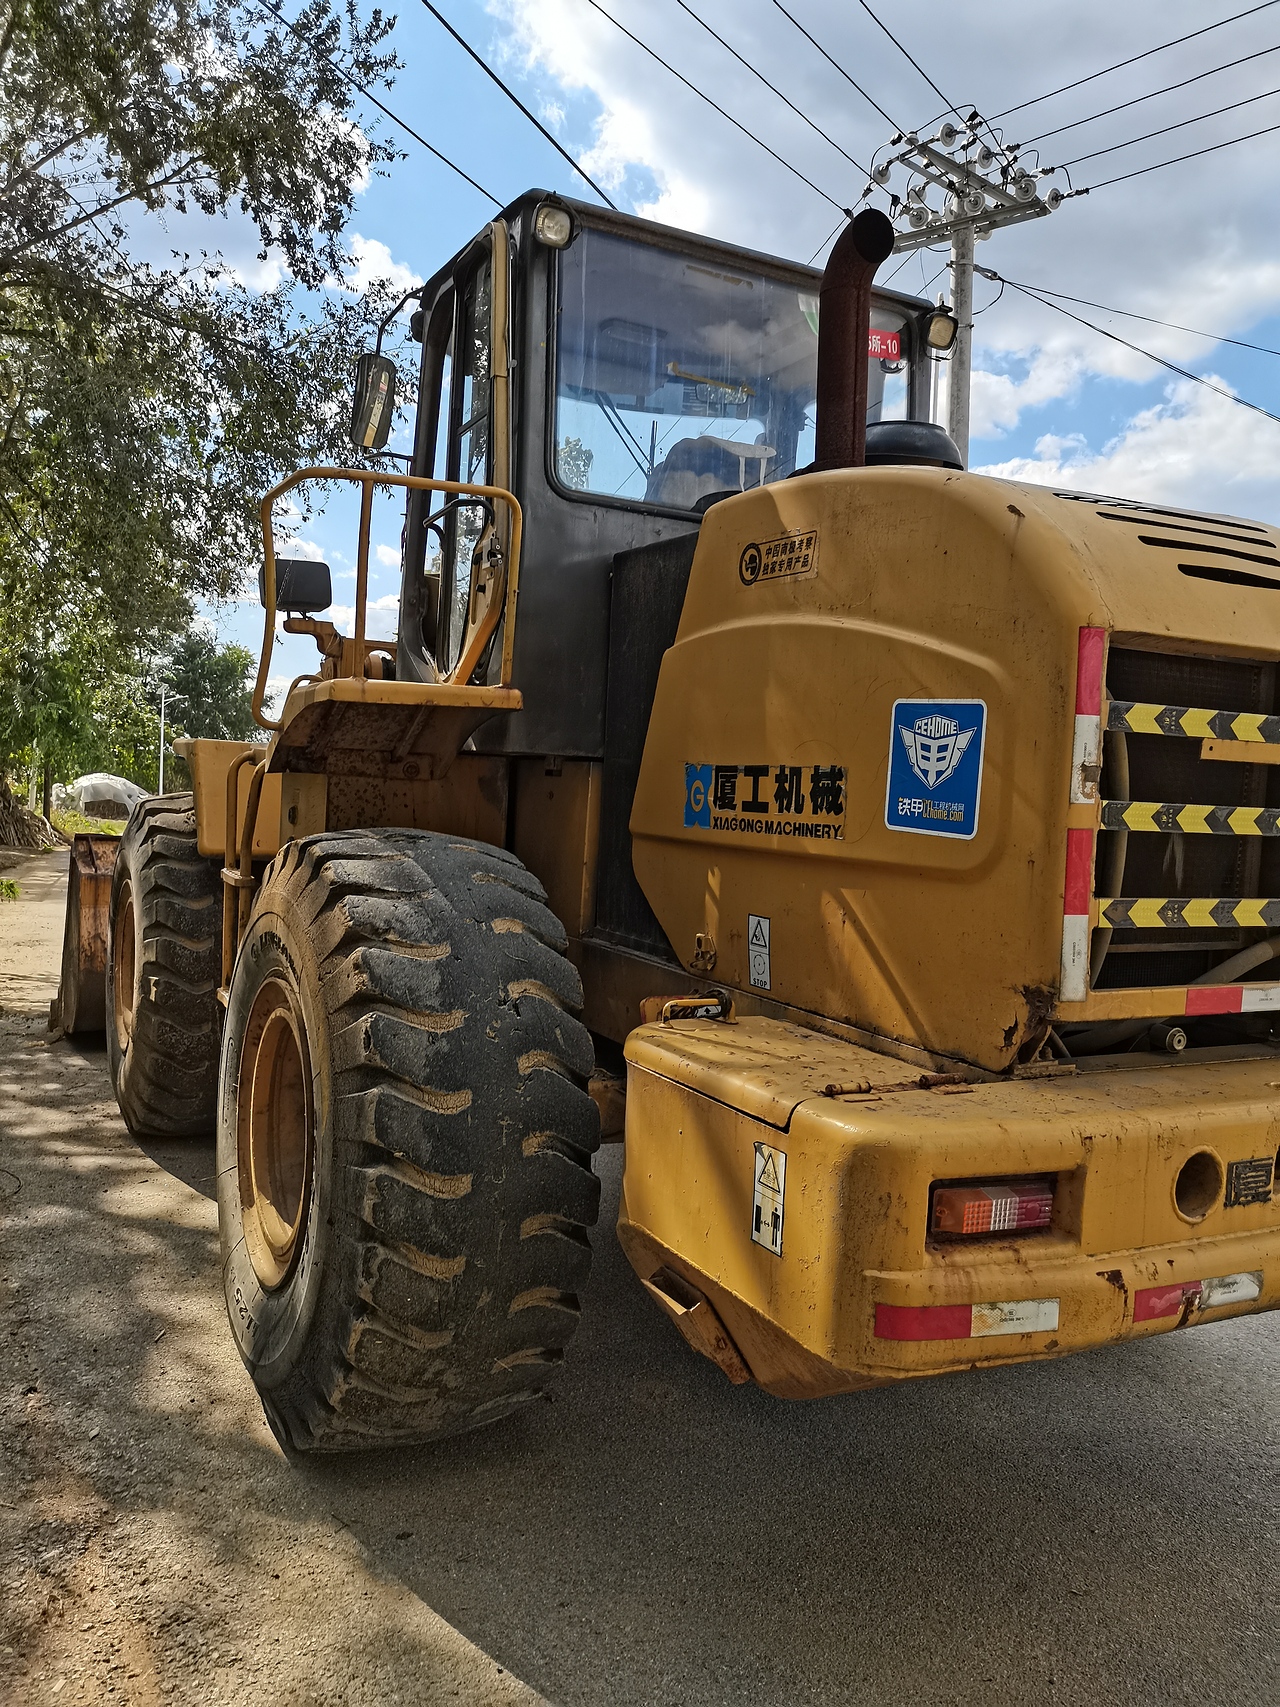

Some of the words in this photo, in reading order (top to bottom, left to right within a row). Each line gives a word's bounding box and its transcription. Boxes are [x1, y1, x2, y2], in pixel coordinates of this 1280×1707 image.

[765, 536, 813, 559] 中国南极考察
[762, 554, 810, 576] 独家专用产品
[915, 716, 957, 738] CEHOME
[713, 765, 844, 816] 厦工机械
[898, 797, 923, 817] 铁甲
[753, 977, 768, 987] STOP
